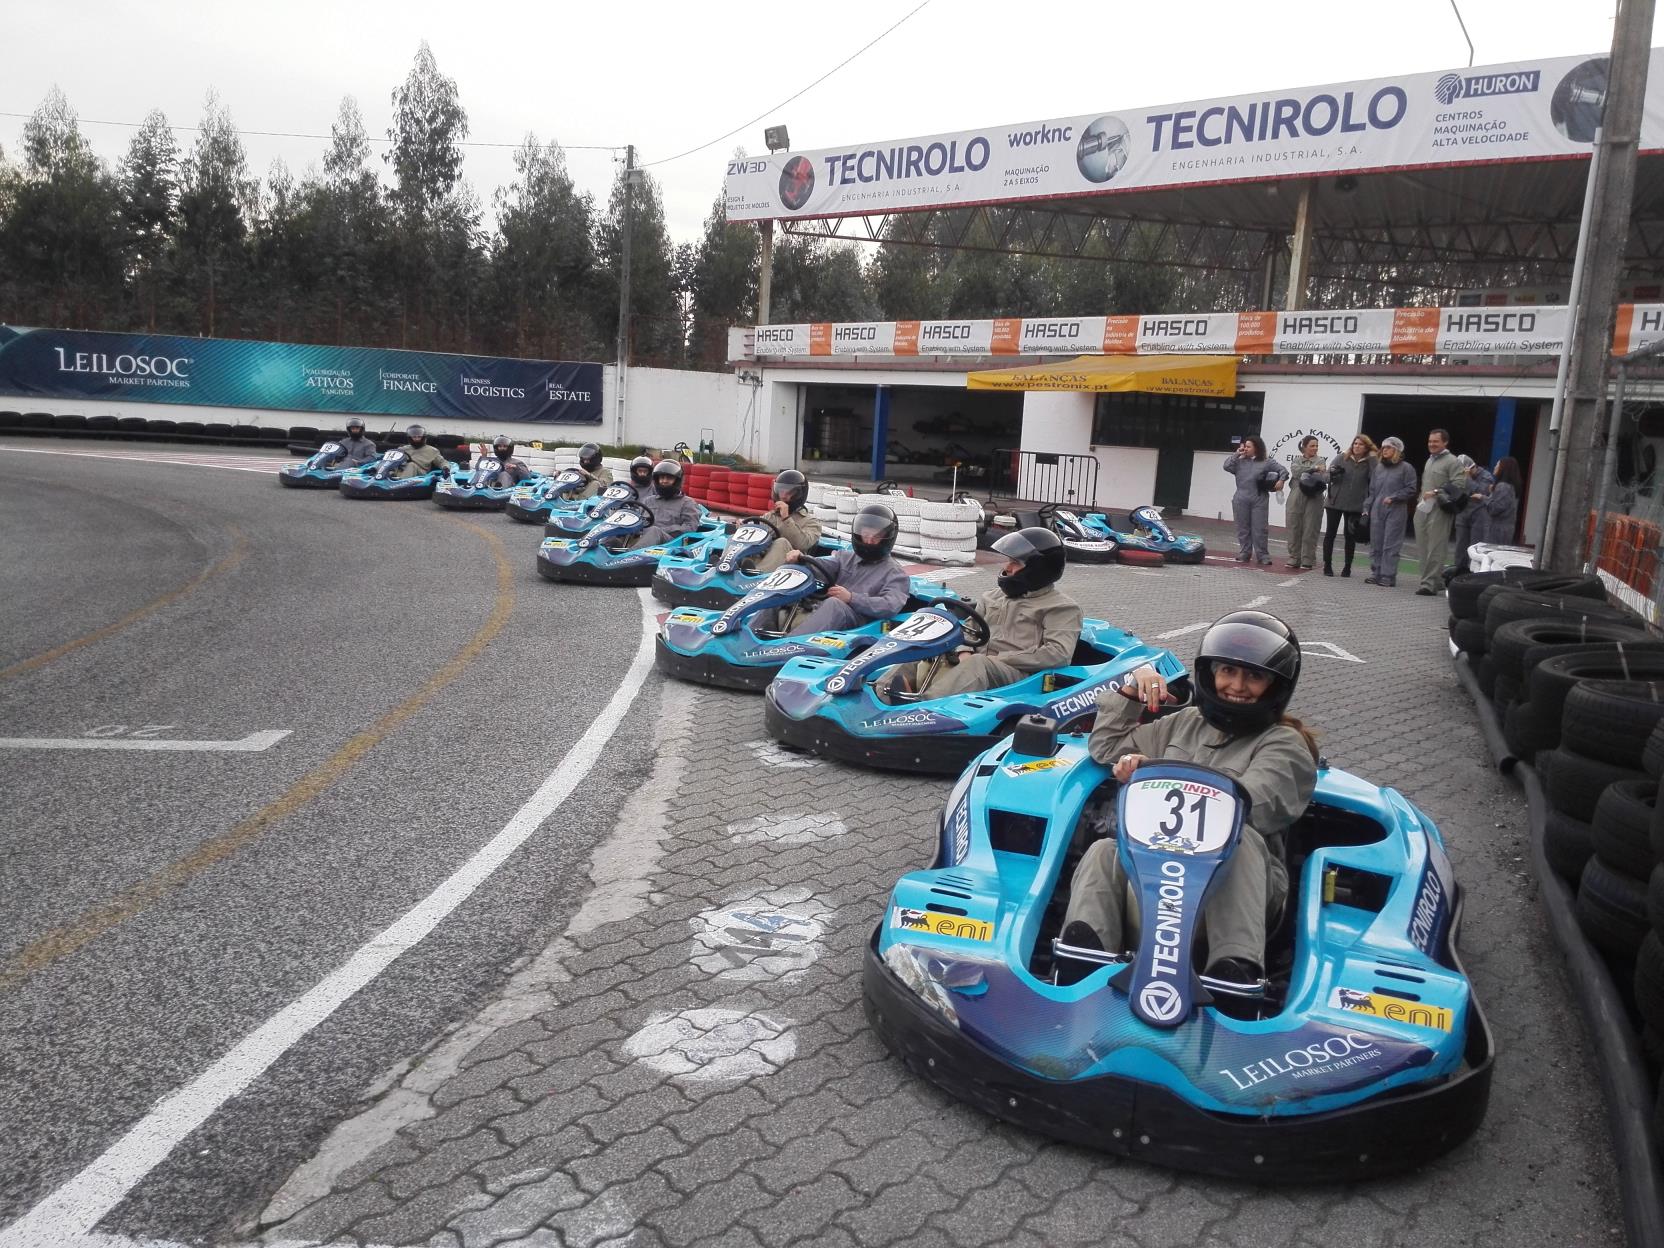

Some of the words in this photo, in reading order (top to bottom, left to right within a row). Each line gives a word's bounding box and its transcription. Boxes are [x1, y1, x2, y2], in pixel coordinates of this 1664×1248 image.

[1470, 74, 1534, 95] HURON
[1146, 86, 1407, 152] TECNIROLO
[1435, 110, 1483, 122] CENTROS
[1434, 120, 1507, 135] MAQUINAÇÃO
[1432, 138, 1458, 147] ALTA
[1461, 132, 1529, 144] VELOCIDADE
[824, 136, 991, 186] TECNIROLO
[1172, 156, 1245, 171] ENGENHARIA
[1251, 149, 1330, 164] INDUSTRIAL,
[842, 190, 890, 202] ENGENHARIA
[1024, 323, 1080, 338] HASCO
[1143, 320, 1208, 336] HASCO
[1283, 316, 1358, 334] HASCO
[1446, 313, 1536, 333] HASCO
[757, 328, 794, 341] HASCO
[835, 327, 877, 340] HASCO
[922, 325, 971, 339] HASCO
[1279, 341, 1320, 351] Enabling
[1443, 339, 1490, 351] Enabling
[1494, 340, 1517, 350] with
[54, 347, 189, 377] LEILOSOC
[109, 376, 145, 385] MARKET
[146, 378, 191, 388] PARTNERS
[305, 376, 354, 389] ATIVOS
[383, 379, 437, 393] FINANCE
[463, 377, 491, 385] BUSINESS
[464, 384, 525, 399] LOGISTICS
[549, 390, 591, 402] ESTATE
[1268, 429, 1303, 459] ESCOLA
[1309, 428, 1345, 455] KARTIN
[606, 488, 621, 498] 32
[614, 514, 626, 523] 8
[737, 529, 756, 541] 21
[764, 572, 793, 587] 30
[897, 616, 937, 637] 24
[1051, 680, 1121, 718] TECNIROO
[860, 712, 936, 728] LEILOSOC
[1141, 781, 1221, 798] EUROINDY
[1160, 788, 1208, 842] 31
[1151, 860, 1186, 978] TECNIROLO
[936, 920, 991, 942] eni
[1383, 1005, 1445, 1031] eni
[1219, 1032, 1374, 1091] LEILOSOC
[1292, 1065, 1334, 1080] MARKET
[1334, 1048, 1382, 1071] PARTNERS
